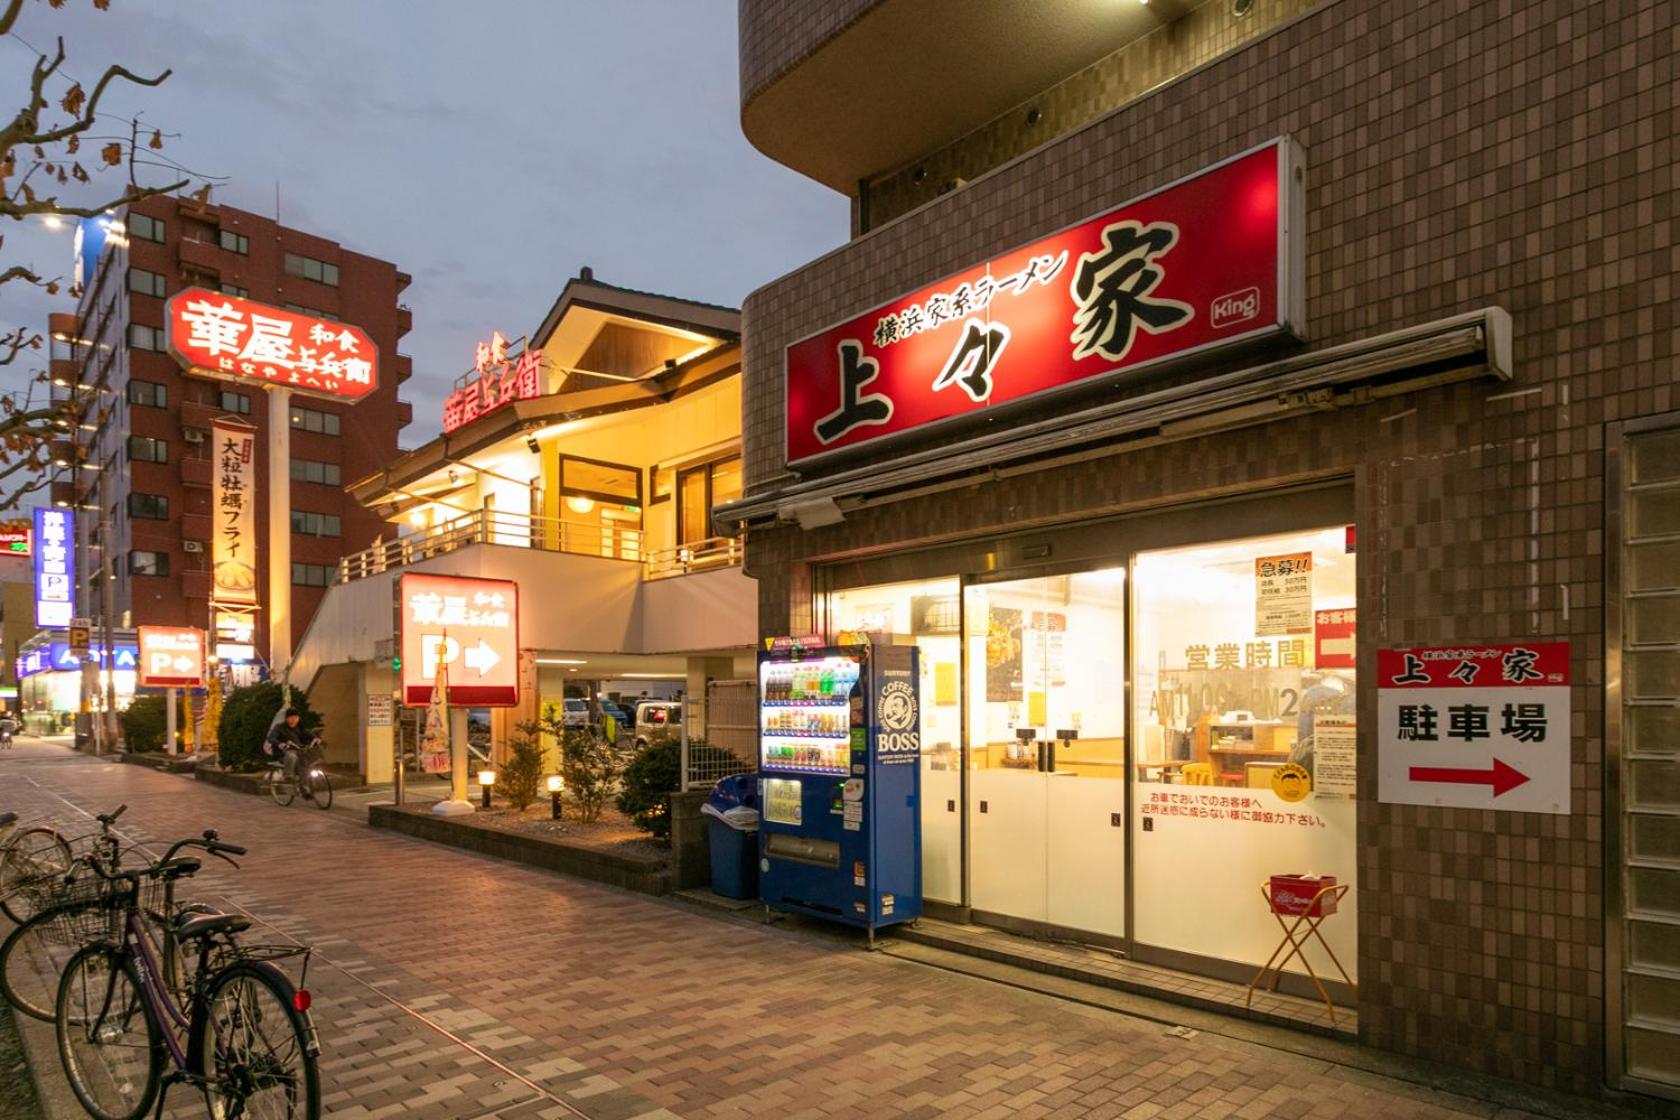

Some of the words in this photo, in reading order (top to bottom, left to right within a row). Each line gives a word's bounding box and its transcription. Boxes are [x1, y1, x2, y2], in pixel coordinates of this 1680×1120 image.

[874, 252, 1068, 346] 横浜家系ラーメン
[1214, 294, 1256, 320] King
[309, 323, 360, 353] 和食
[813, 220, 1195, 444] 上々家
[221, 437, 243, 558] 大粒牡蠣フライ
[421, 634, 460, 680] P
[1185, 639, 1306, 671] 営業時間
[1392, 649, 1544, 686] 上々家
[878, 732, 919, 752] BOSS
[1397, 703, 1548, 743] 駐車場
